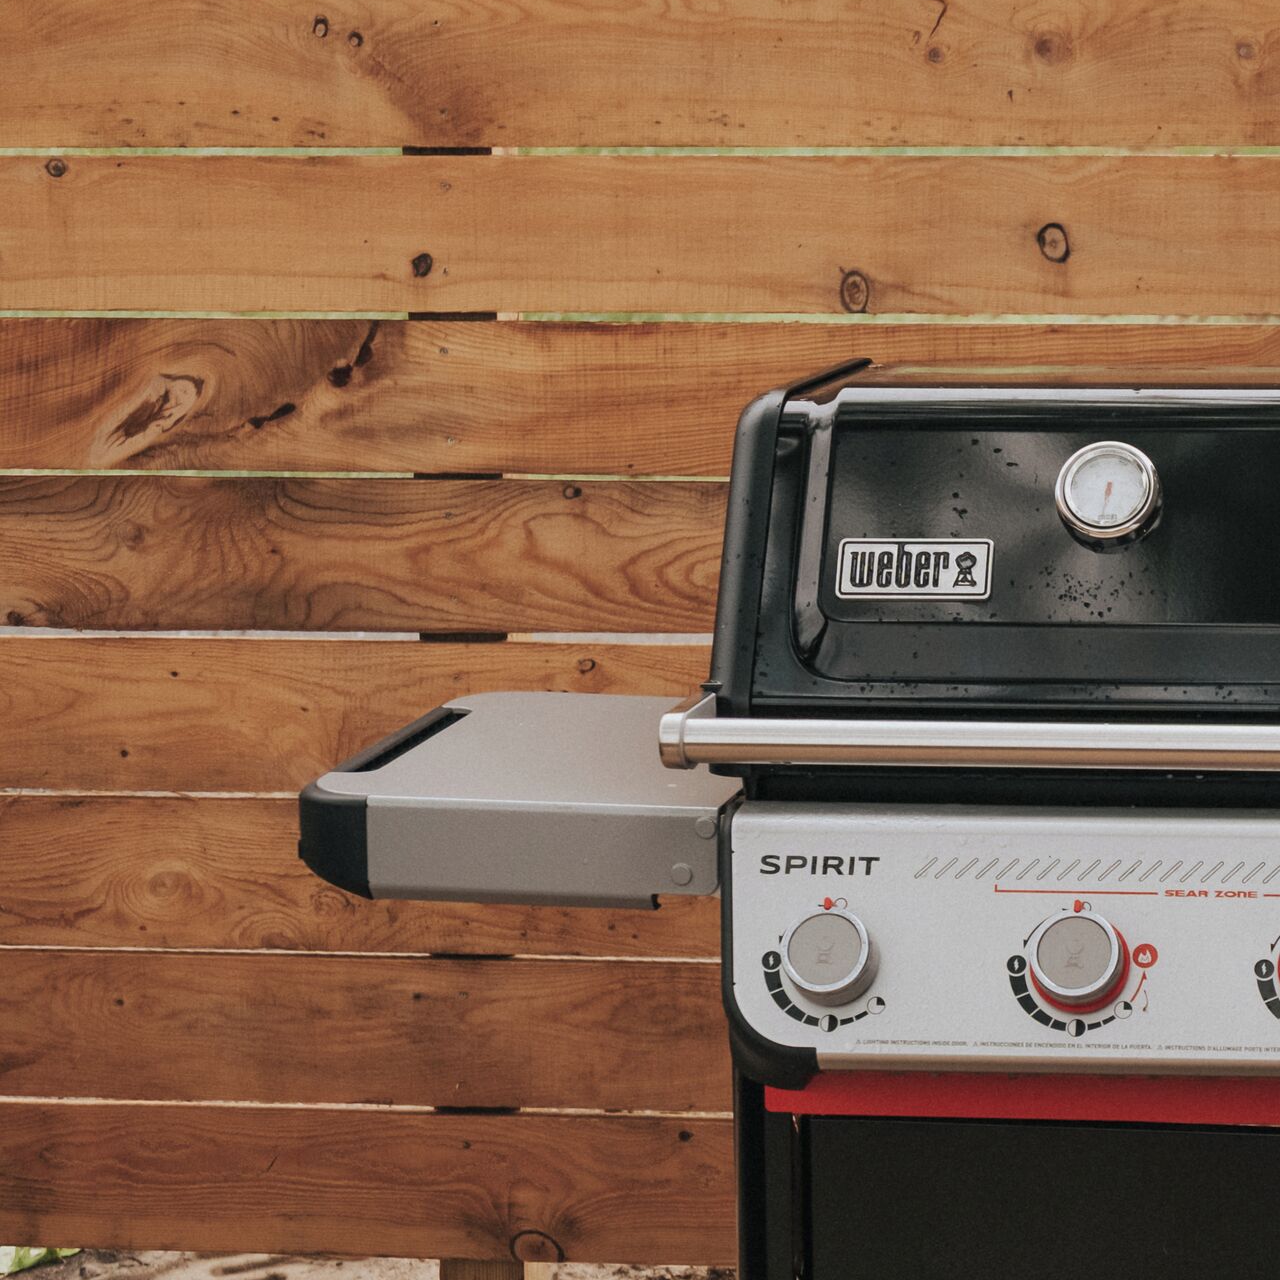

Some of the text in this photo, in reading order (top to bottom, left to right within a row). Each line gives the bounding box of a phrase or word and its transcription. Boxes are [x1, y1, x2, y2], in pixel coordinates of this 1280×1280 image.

[850, 543, 949, 588] weber
[760, 854, 880, 876] SPIRIT
[1164, 889, 1257, 898] SEAR ZONE
